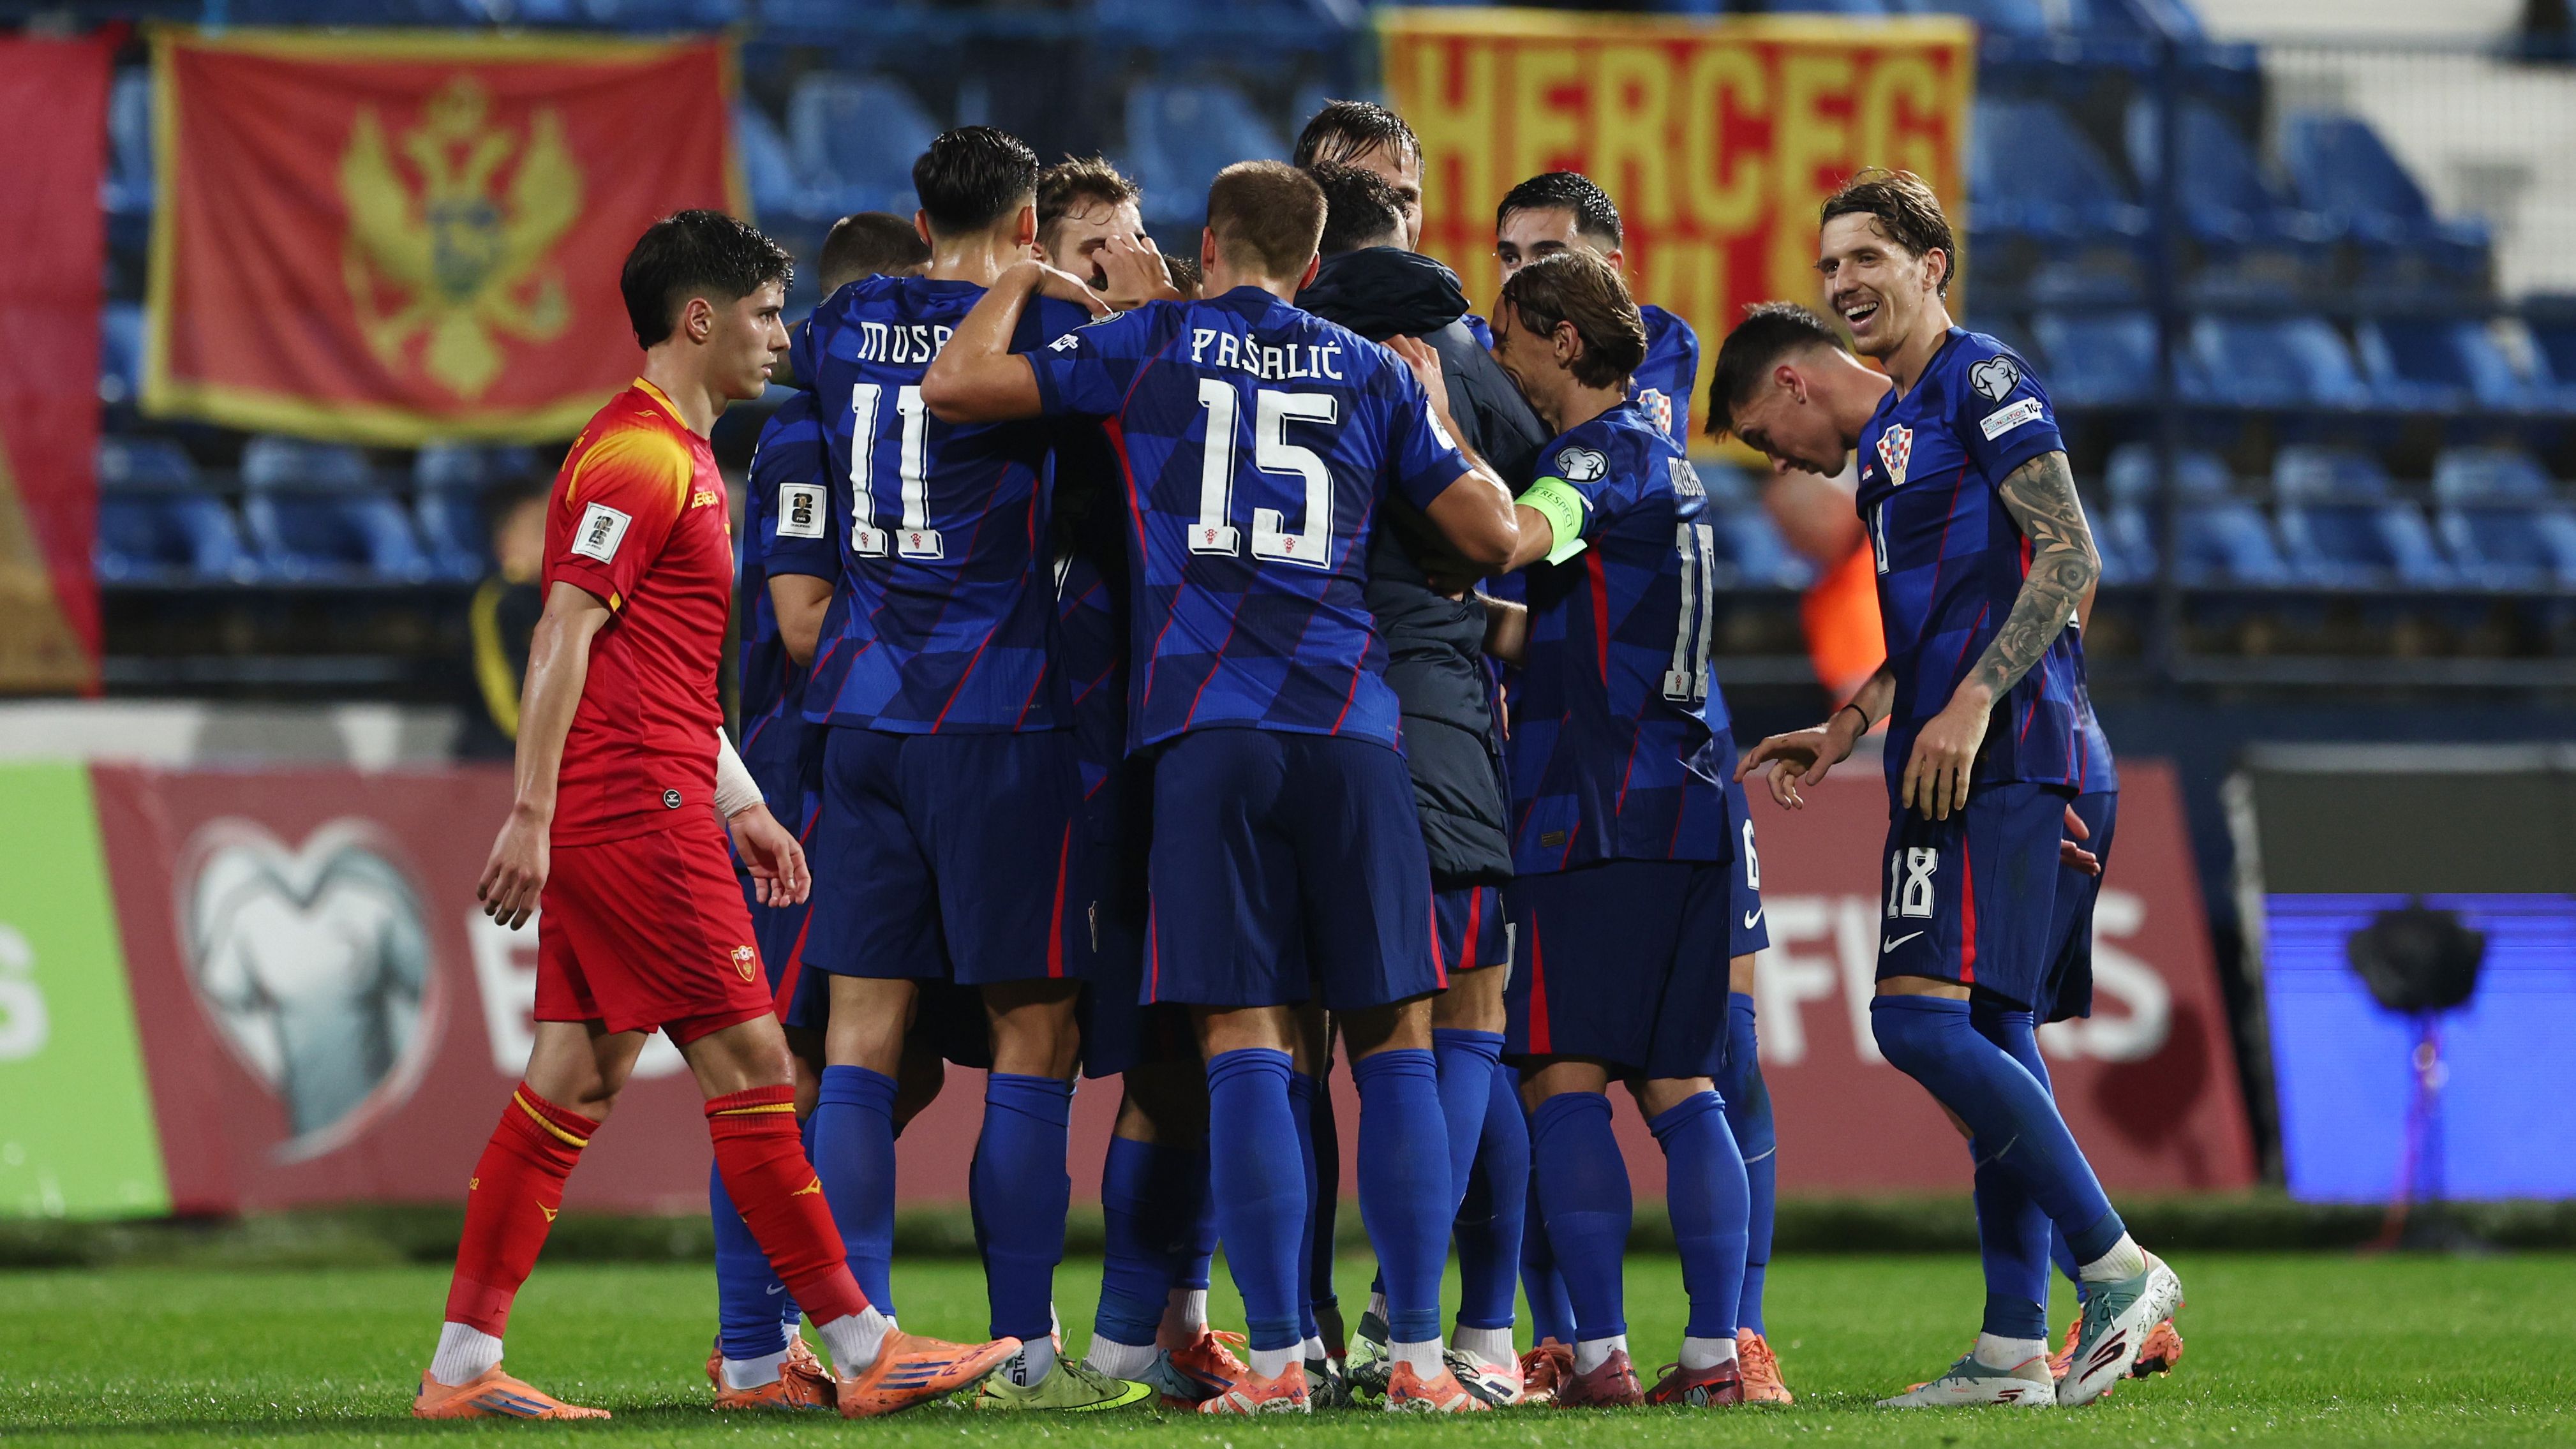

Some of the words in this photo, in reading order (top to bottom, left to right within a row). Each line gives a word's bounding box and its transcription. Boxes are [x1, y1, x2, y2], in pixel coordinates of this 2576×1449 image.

[1413, 43, 1943, 233] HERCEG
[1191, 328, 1343, 381] PAŠALIĆ
[1984, 408, 2026, 433] FOUNDATION
[849, 383, 944, 560] 11
[1187, 377, 1338, 570] 15
[1540, 489, 1573, 528] RESPECT
[1742, 819, 1761, 890] 6
[1886, 847, 1939, 919] 18
